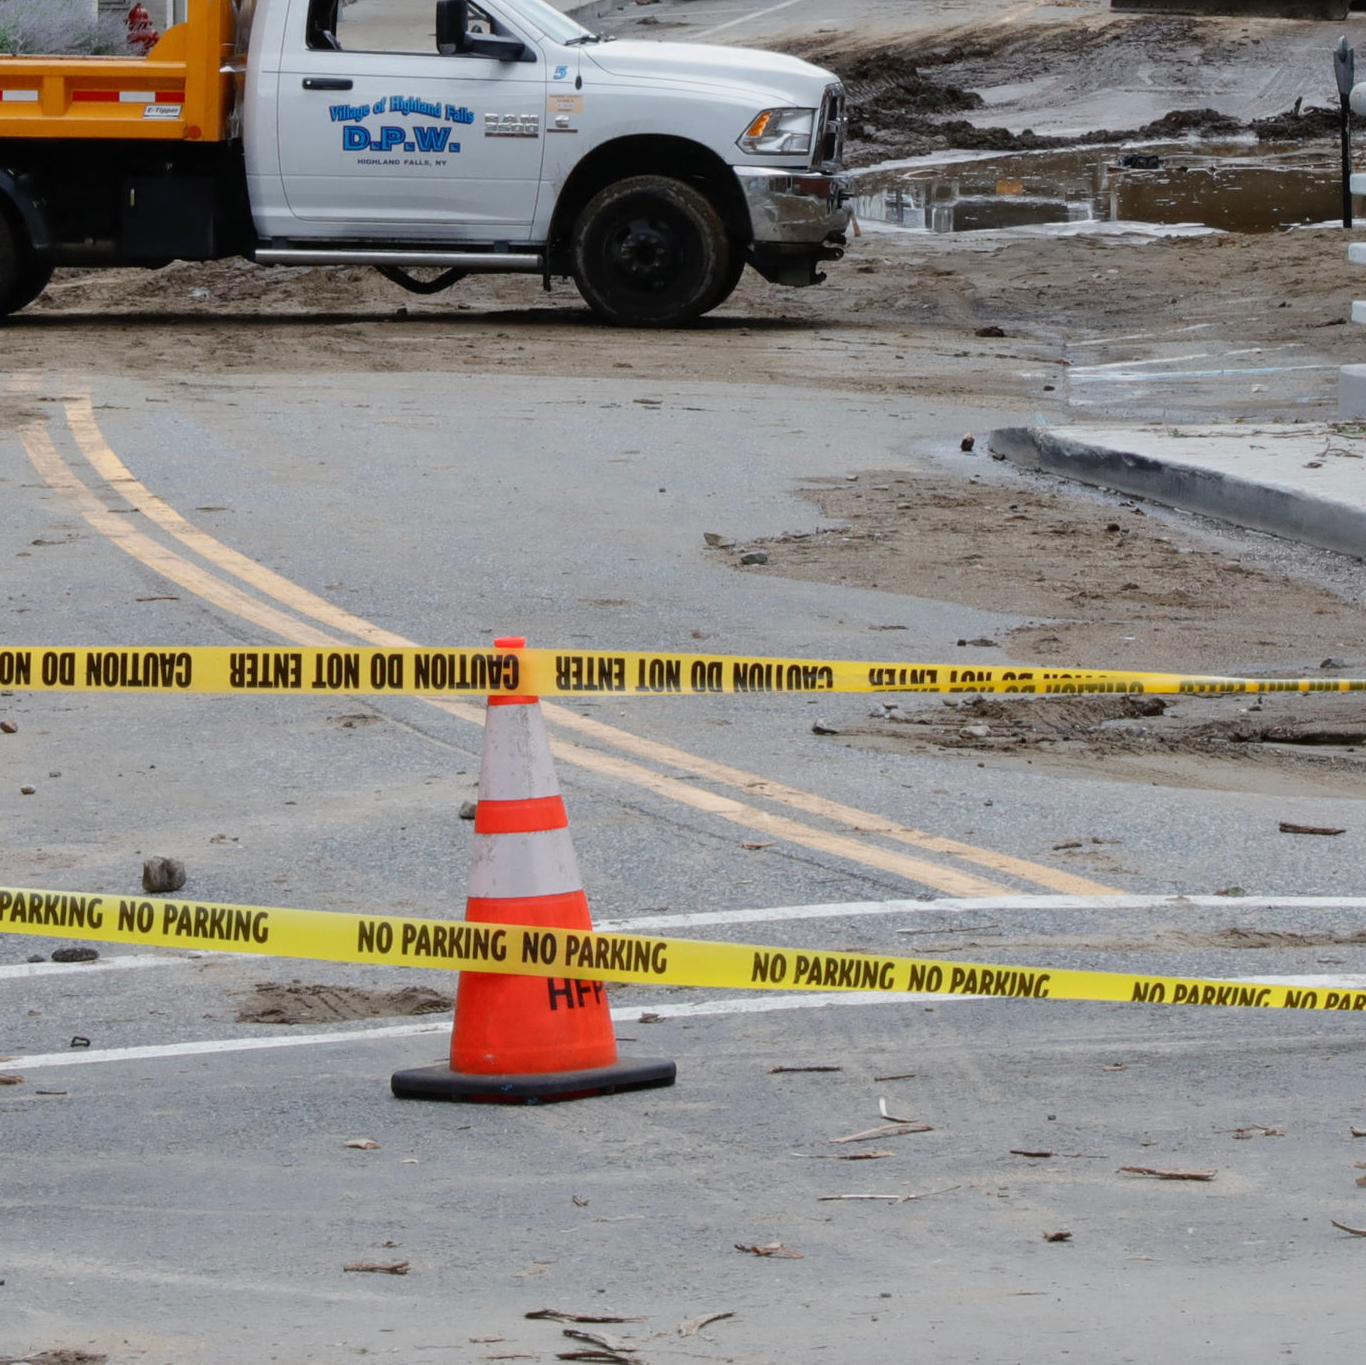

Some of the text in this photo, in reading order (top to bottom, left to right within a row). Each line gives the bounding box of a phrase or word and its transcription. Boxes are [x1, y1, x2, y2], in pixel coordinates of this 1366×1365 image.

[553, 65, 568, 80] 5
[329, 95, 475, 125] Village of Highland Falls
[484, 113, 539, 123] RAM
[342, 125, 461, 153] D.P.W.
[357, 158, 400, 166] HIGHLAND
[404, 159, 432, 167] FALLS,
[42, 652, 75, 687] DO
[86, 652, 192, 688] CAUTION
[230, 653, 519, 690] CAUTION DO NOT ENTER
[556, 656, 626, 691] ENTER
[635, 658, 681, 692] NOT
[691, 660, 724, 692] DO
[118, 900, 269, 944] NO PARKING
[358, 921, 506, 962] NO PARKING
[522, 931, 667, 975] NO PARKING
[751, 952, 895, 991] NO PARKING
[907, 963, 1051, 999] NO PARKING
[1131, 981, 1165, 1003] NO
